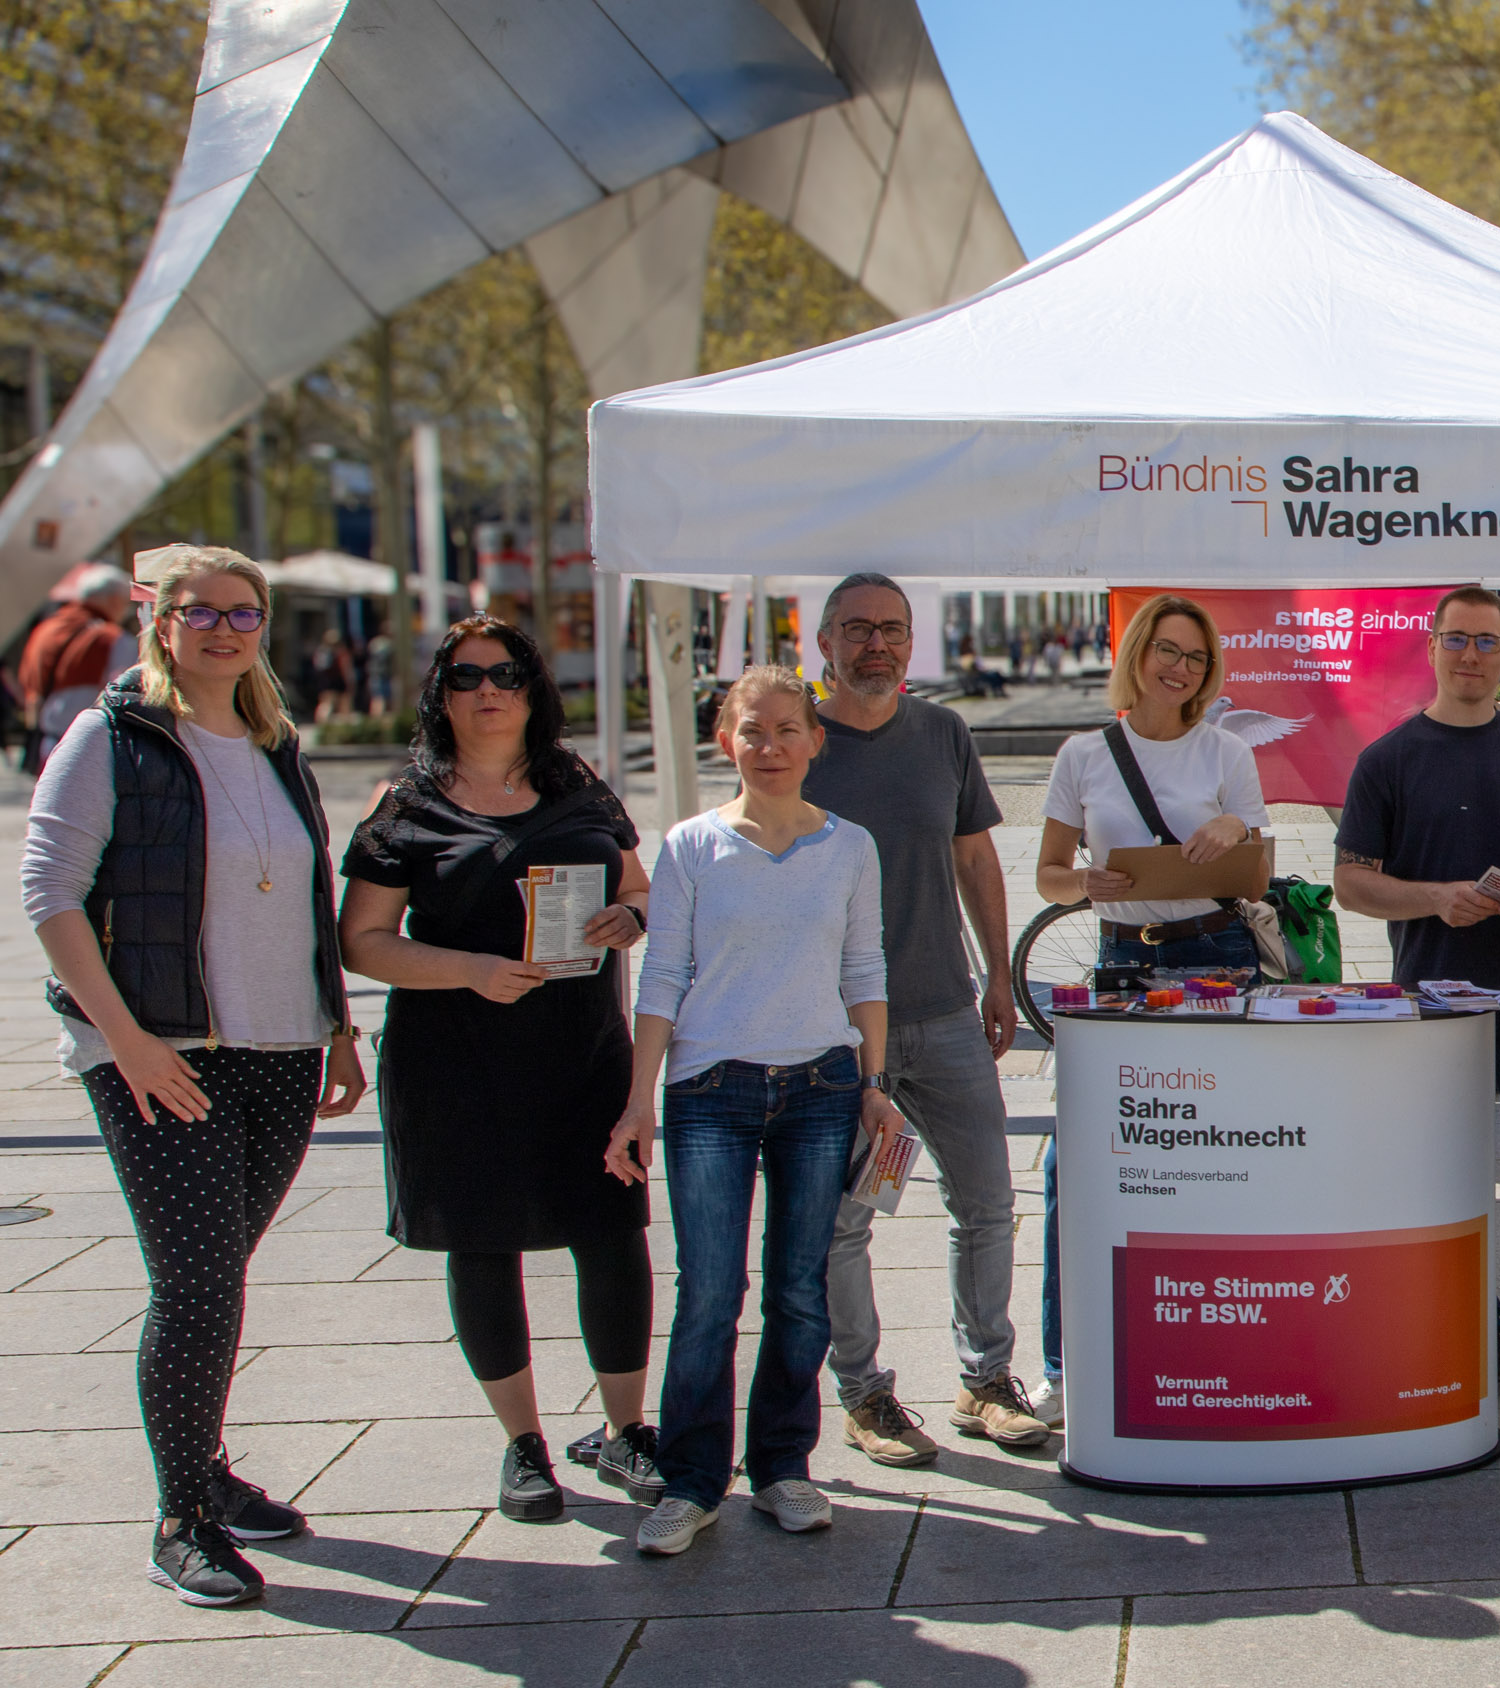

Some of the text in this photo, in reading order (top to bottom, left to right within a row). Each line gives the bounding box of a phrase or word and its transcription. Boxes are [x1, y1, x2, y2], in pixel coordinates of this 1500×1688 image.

[1099, 454, 1420, 494] Bündnis Sahra
[1118, 1064, 1217, 1091] Bündnis
[1118, 1095, 1198, 1120] Sahra
[1118, 1121, 1307, 1151] Wagenknecht
[1119, 1167, 1249, 1182] BSW Landesverband
[1119, 1182, 1177, 1196] Sachsen
[1154, 1275, 1315, 1298] Ihre Stimme
[1154, 1303, 1268, 1324] für BSW.
[1155, 1374, 1229, 1390] Vernunft
[1398, 1381, 1463, 1399] sn.bsw-vg.de
[1155, 1392, 1313, 1410] und Gerechtigkeit.
